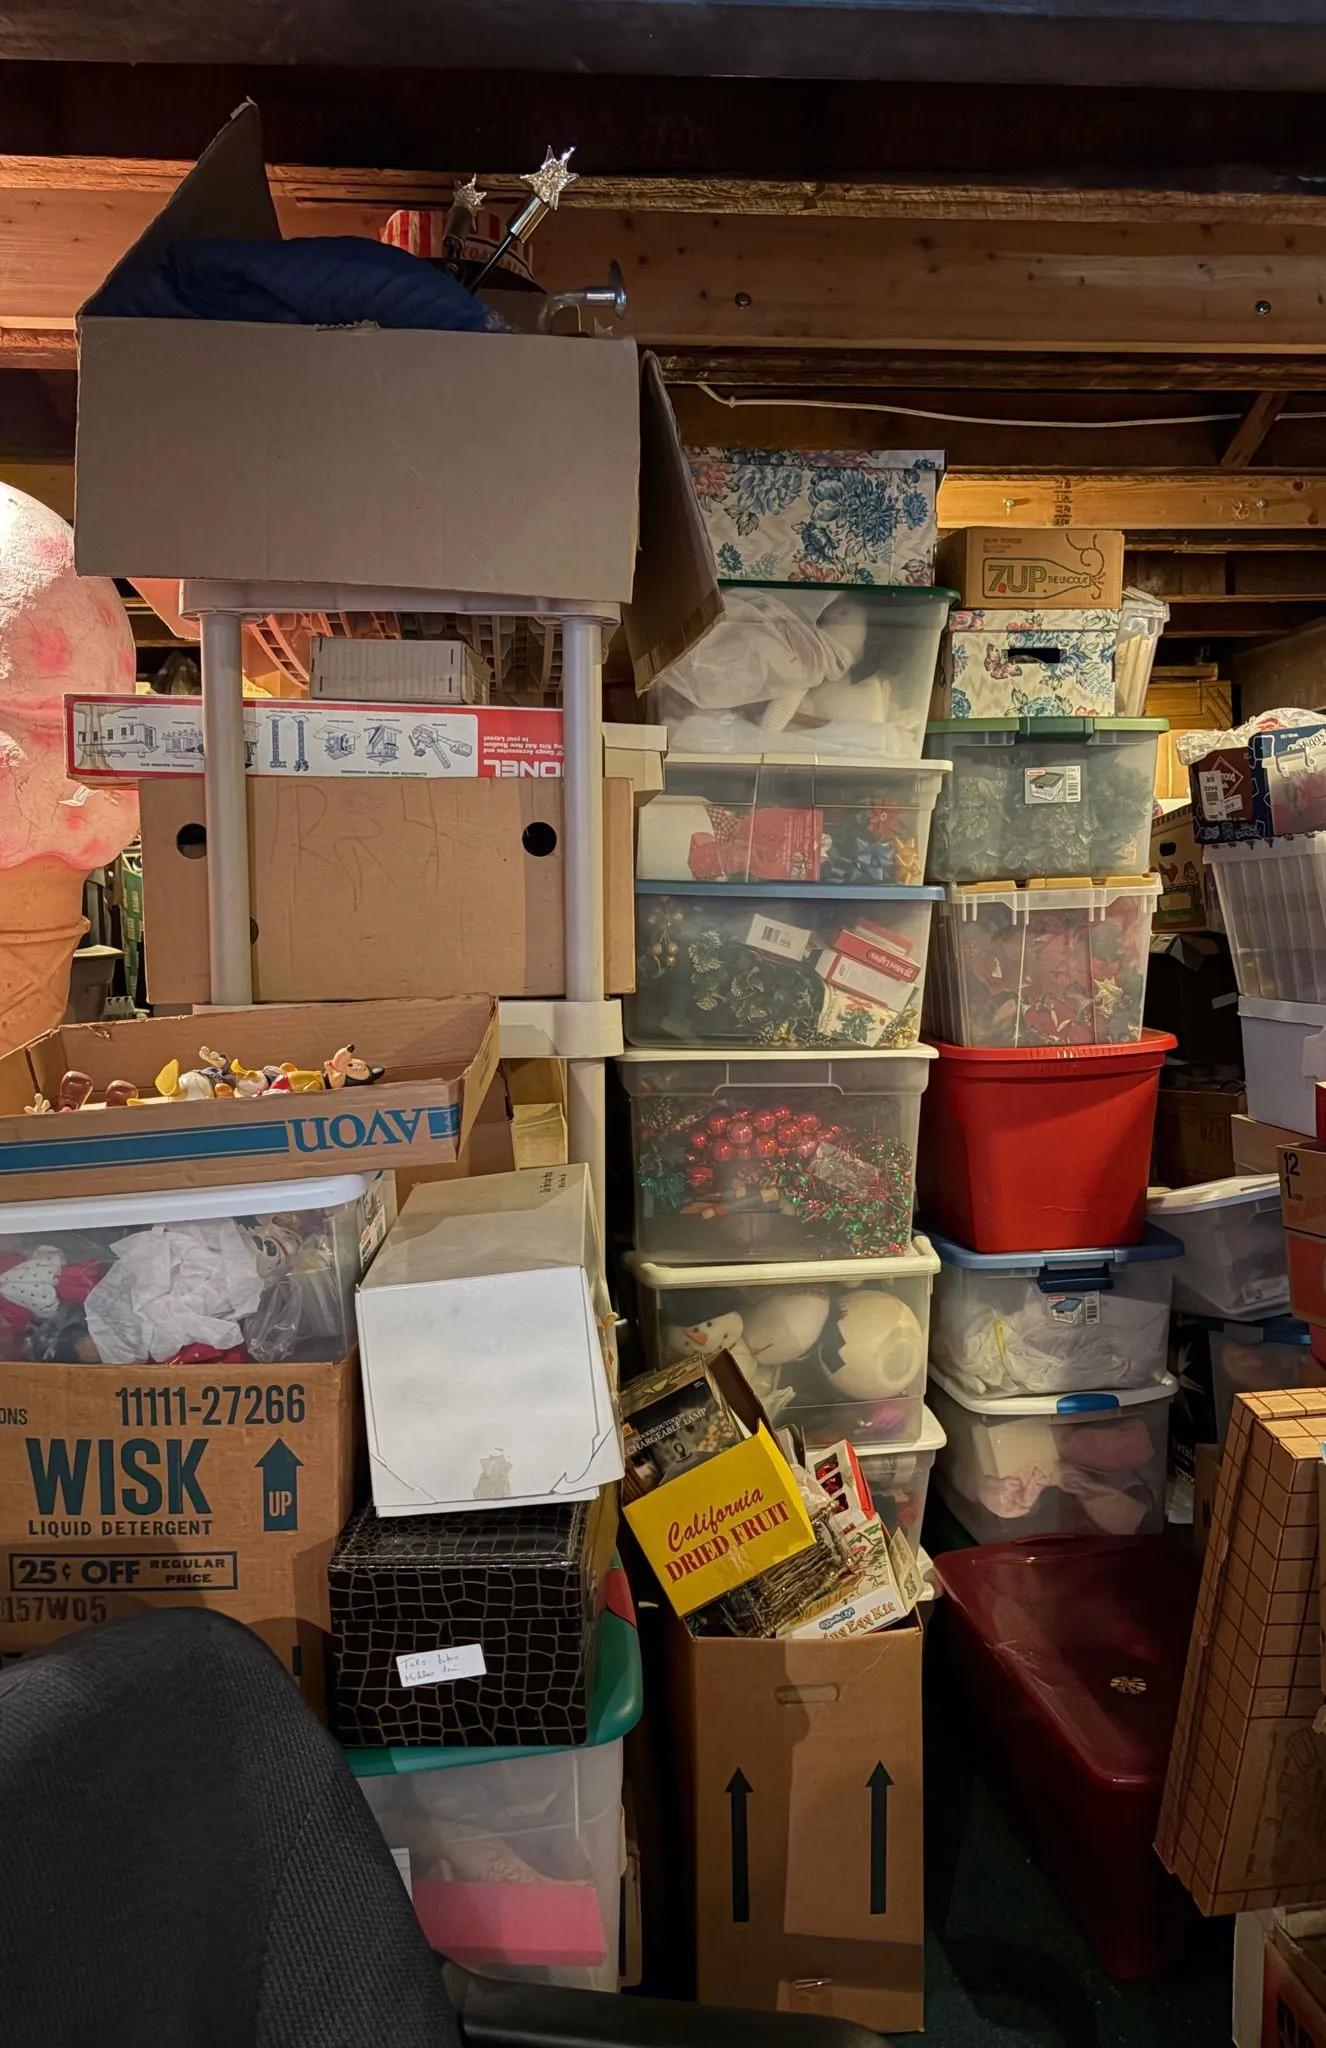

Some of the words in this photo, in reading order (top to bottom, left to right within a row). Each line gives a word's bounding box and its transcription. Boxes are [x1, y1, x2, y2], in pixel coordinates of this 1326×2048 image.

[1282, 1151, 1300, 1176] 12
[115, 1384, 305, 1427] 11111-27266
[681, 1407, 708, 1432] LAMP
[25, 1438, 212, 1516] WISK
[269, 1490, 292, 1517] UP
[28, 1520, 92, 1538] LIQUID
[102, 1519, 213, 1536] DETERGENT
[666, 1487, 764, 1553] California
[664, 1531, 730, 1584] DRIED
[728, 1501, 791, 1549] FRUIT
[81, 1560, 141, 1585] OFF
[150, 1558, 226, 1570] REGULAR
[165, 1573, 213, 1585] PRICE
[846, 1613, 874, 1636] Egg
[872, 1600, 896, 1624] Kit
